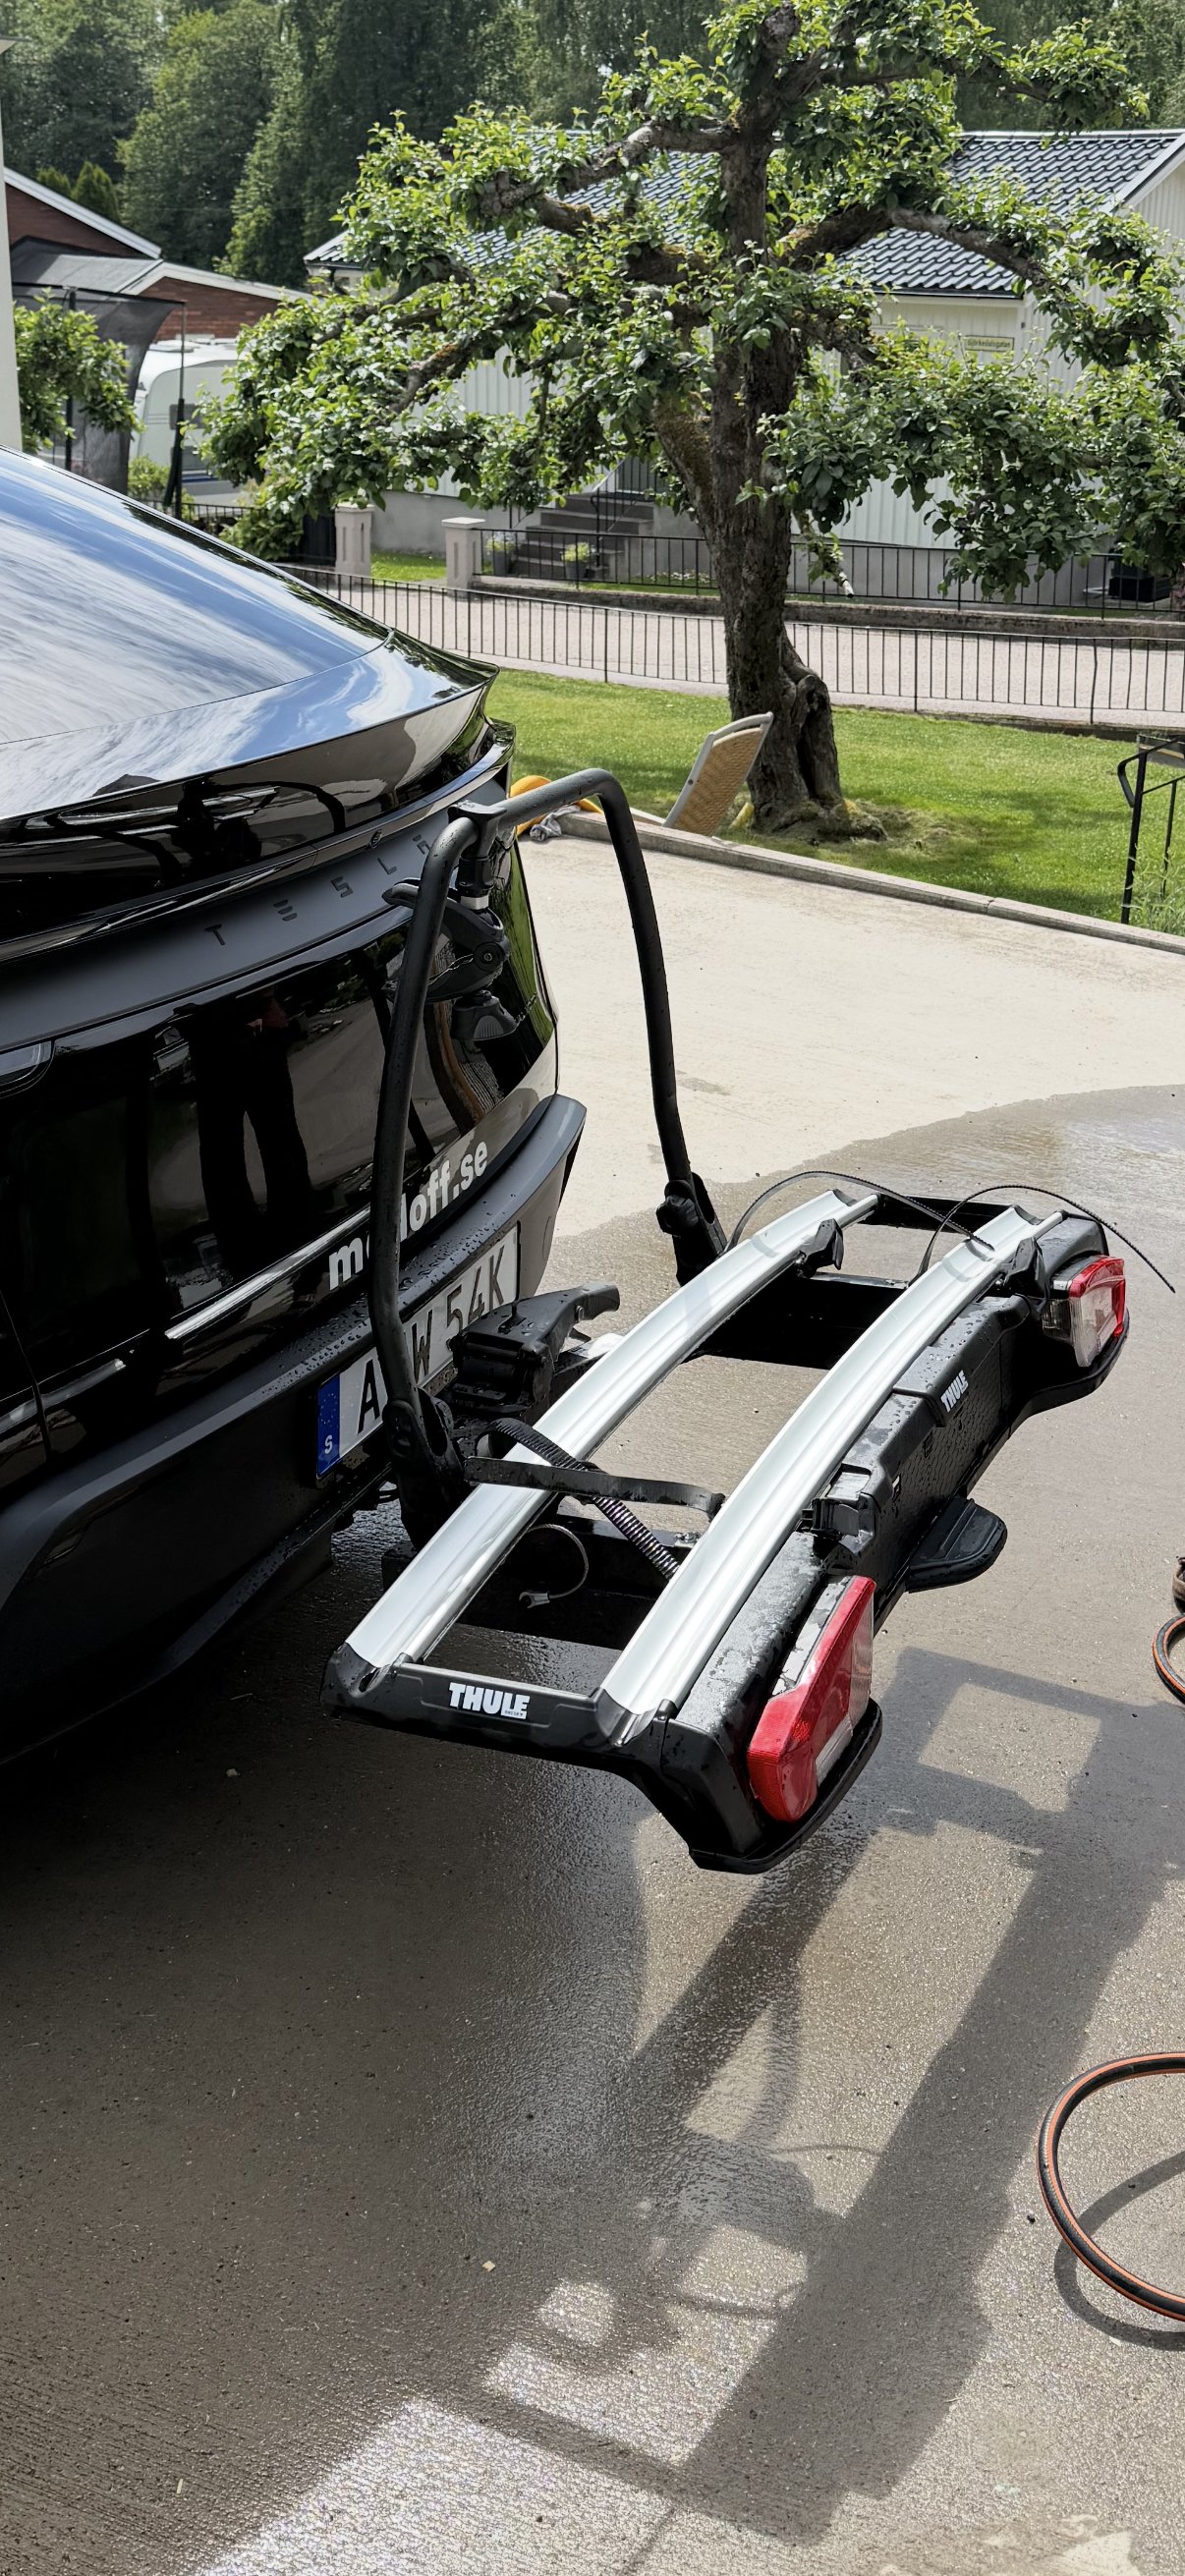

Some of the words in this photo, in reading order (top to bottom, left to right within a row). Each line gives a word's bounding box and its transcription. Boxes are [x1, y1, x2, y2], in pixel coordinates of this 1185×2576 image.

[357, 1309, 432, 1434] AW
[446, 1245, 505, 1351] 54K
[940, 1370, 969, 1413] THULE
[324, 1433, 333, 1455] S
[449, 1682, 530, 1720] THULE
